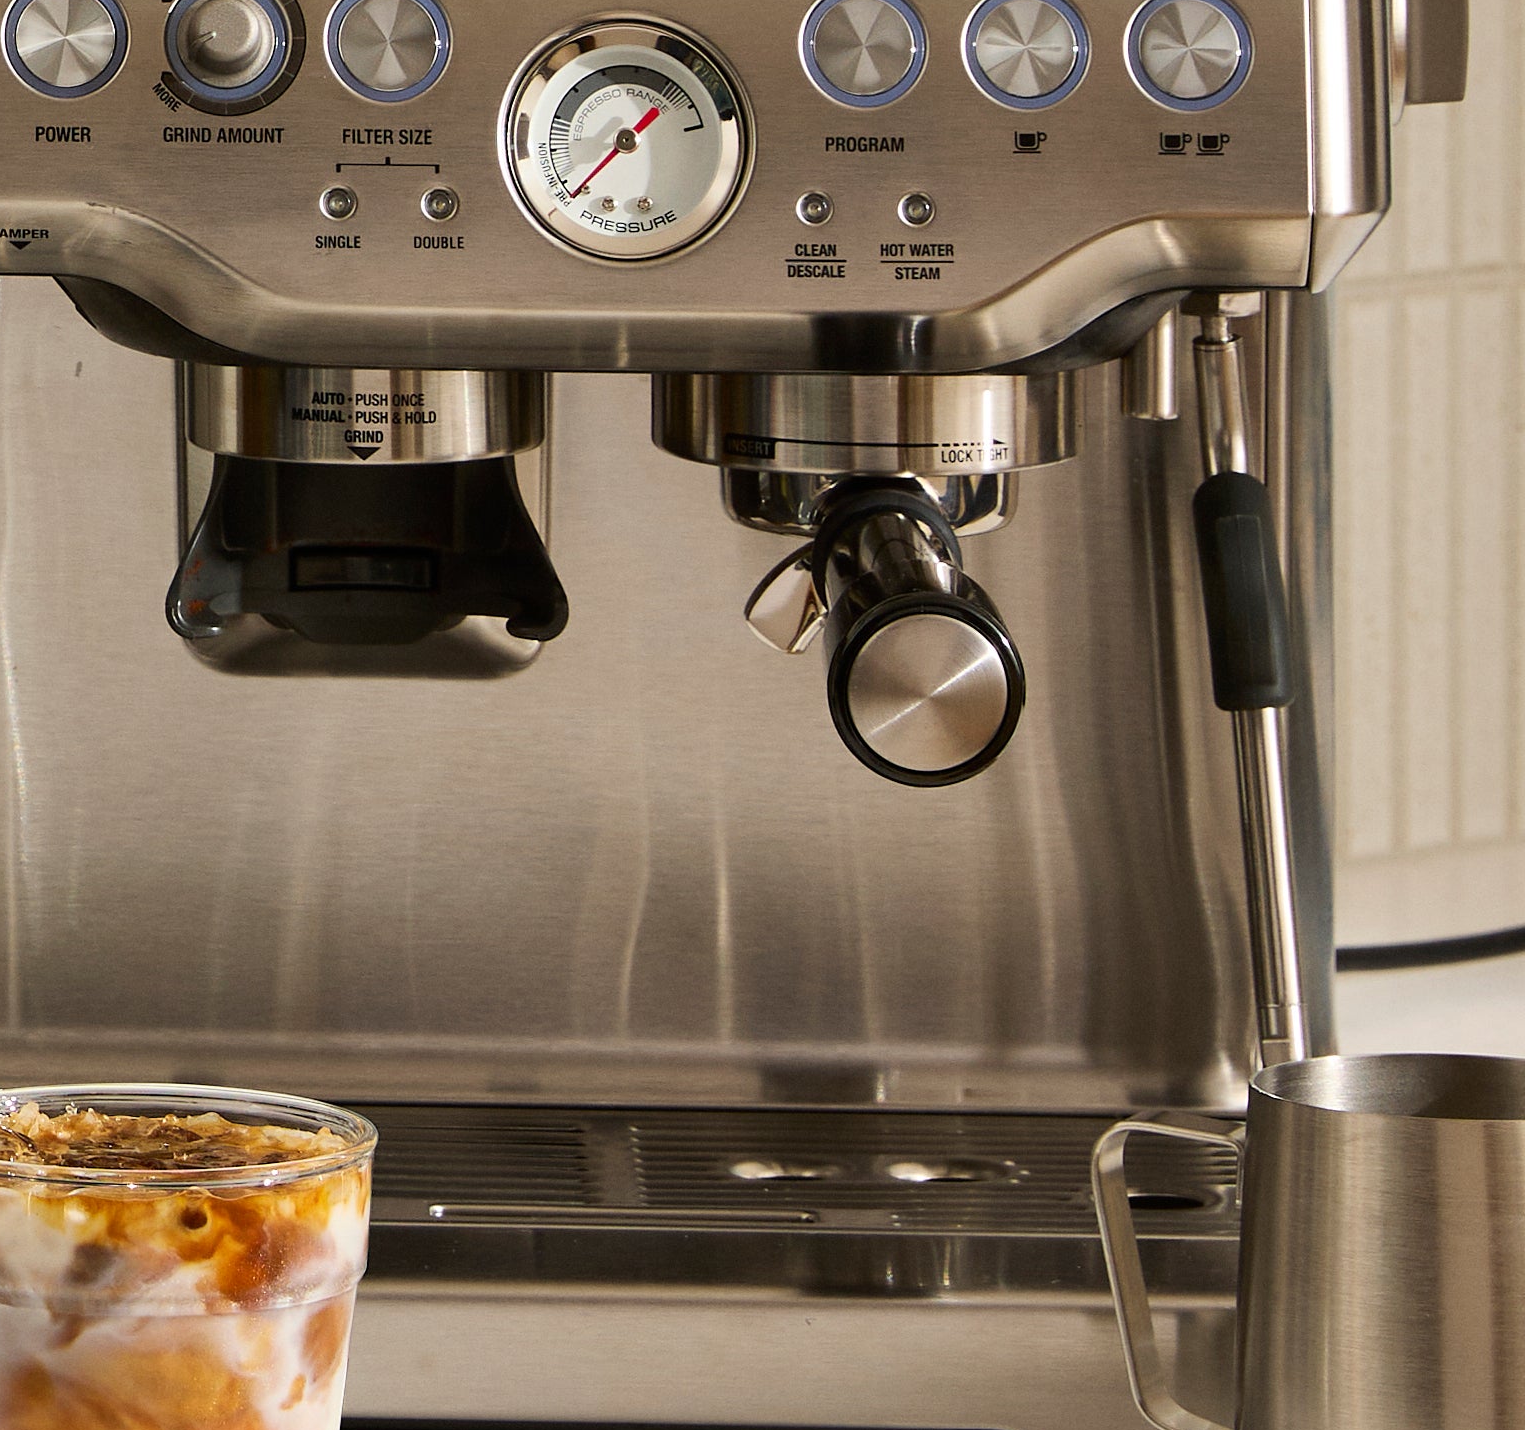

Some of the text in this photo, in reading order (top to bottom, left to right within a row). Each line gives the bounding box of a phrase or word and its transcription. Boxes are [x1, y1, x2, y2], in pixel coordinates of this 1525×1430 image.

[152, 82, 182, 113] MORE
[574, 87, 670, 141] ESPRESSO RANGE
[36, 126, 90, 142] POWER
[163, 127, 284, 143] GRIND AMOUNT
[343, 129, 432, 145] FILTER SIZE
[826, 137, 904, 152] PROGRAM
[538, 142, 571, 207] PRE-INFUSION
[580, 210, 677, 232] PRESSURE
[316, 236, 360, 248] SINGLE
[414, 236, 464, 249] DOUBLE
[795, 244, 836, 256] CLEAN
[880, 244, 954, 256] HOT WATER
[788, 265, 845, 278] DESCALE
[895, 267, 940, 280] STEAM
[311, 391, 424, 407] AUTO PUSH ONCE
[291, 408, 437, 424] MANUAL PUSH & HOLD
[344, 429, 384, 443] GRIND
[941, 447, 1008, 463] LOCK TGHT
